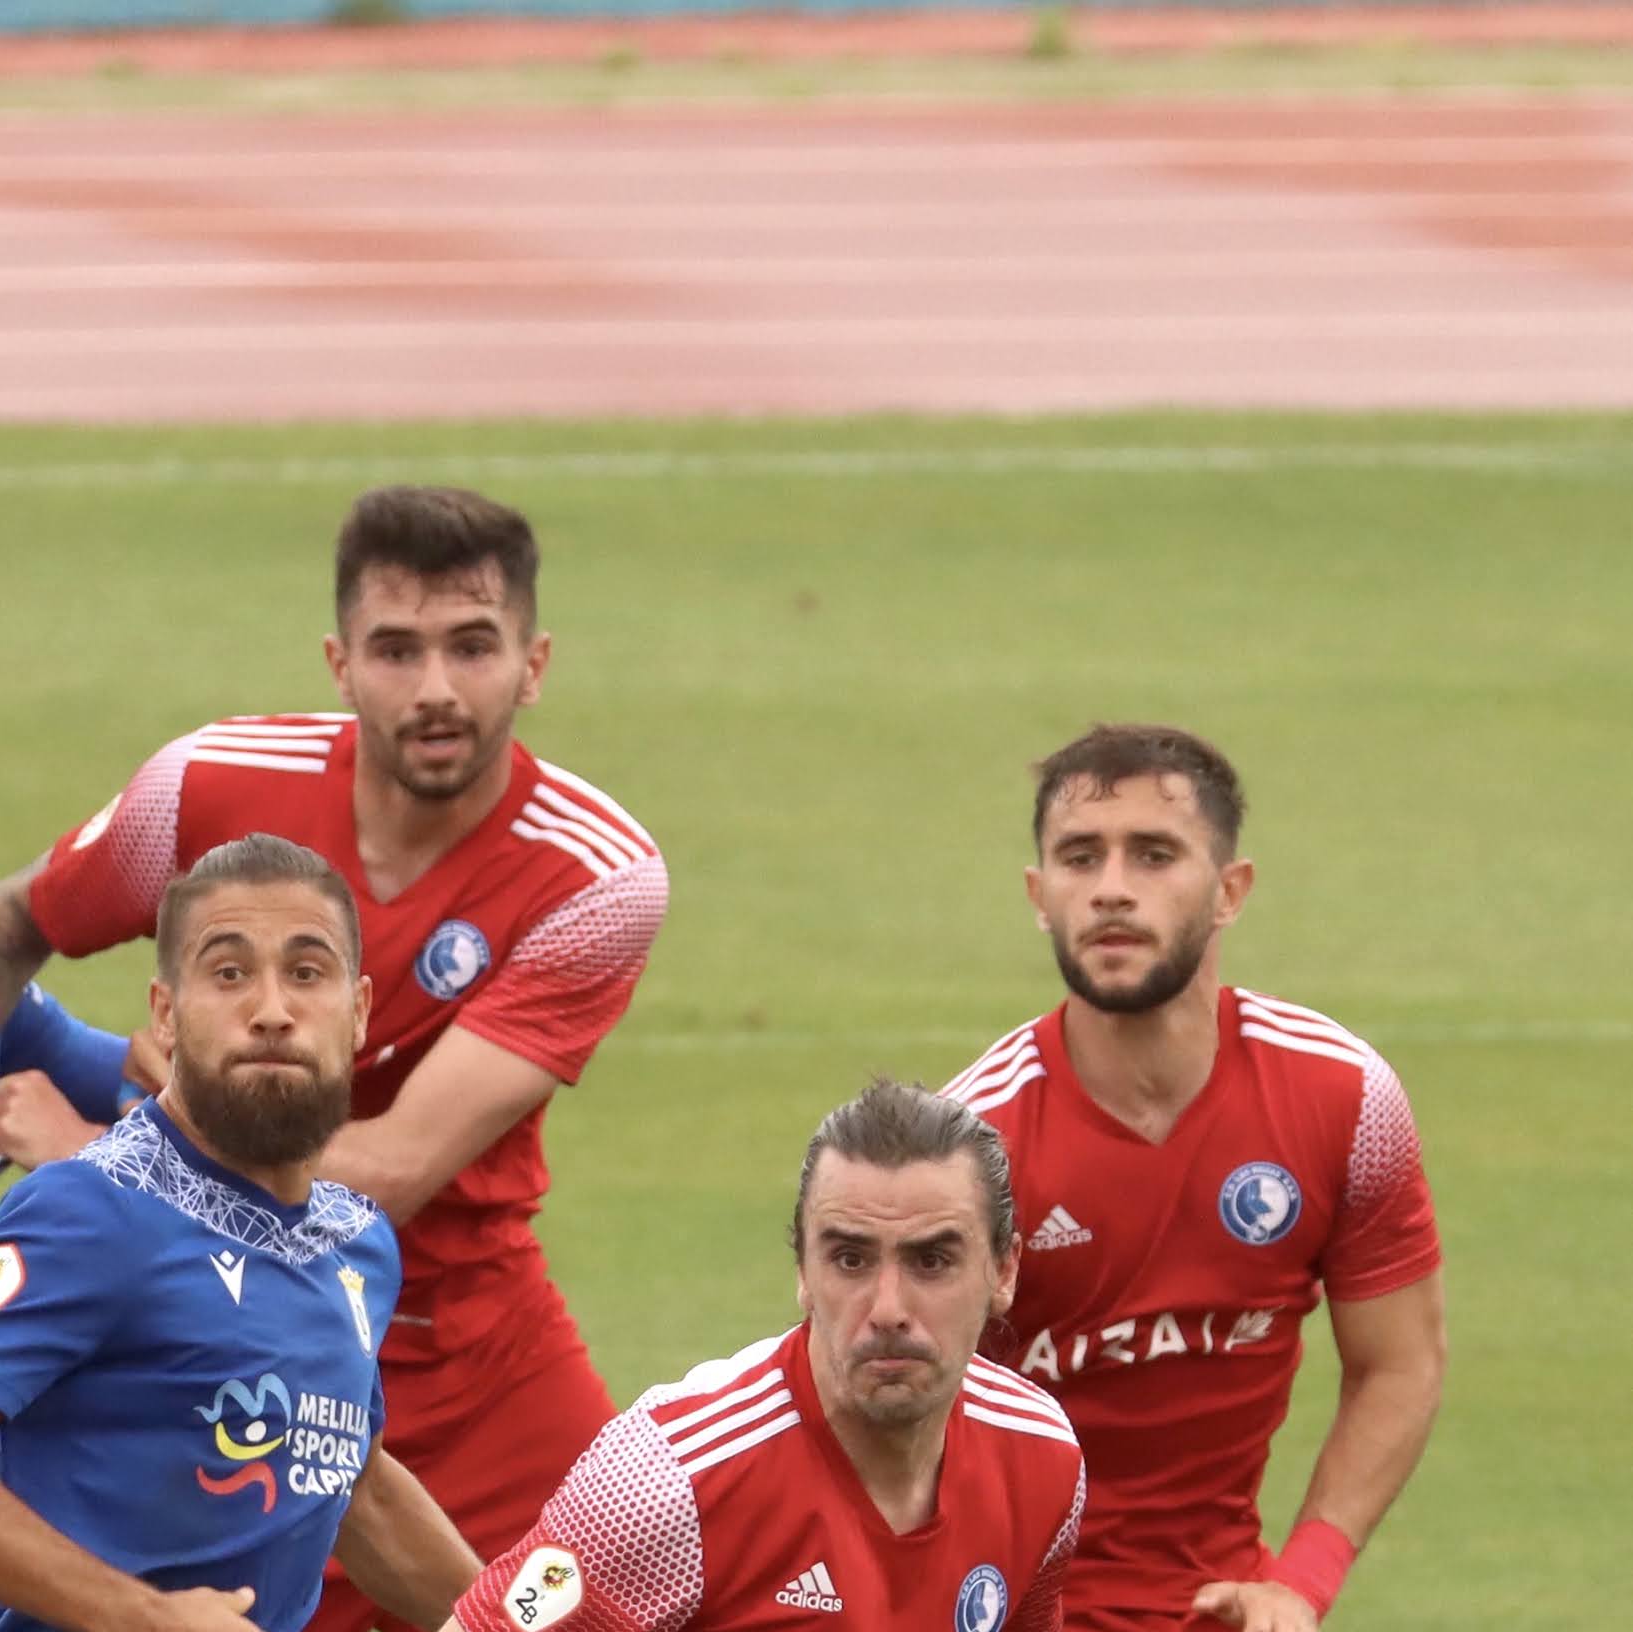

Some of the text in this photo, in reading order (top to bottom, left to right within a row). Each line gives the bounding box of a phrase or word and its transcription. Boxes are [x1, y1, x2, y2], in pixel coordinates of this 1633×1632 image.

[1027, 1228, 1093, 1251] adidas
[288, 1463, 358, 1496] CAPIT
[775, 1589, 843, 1613] adidas
